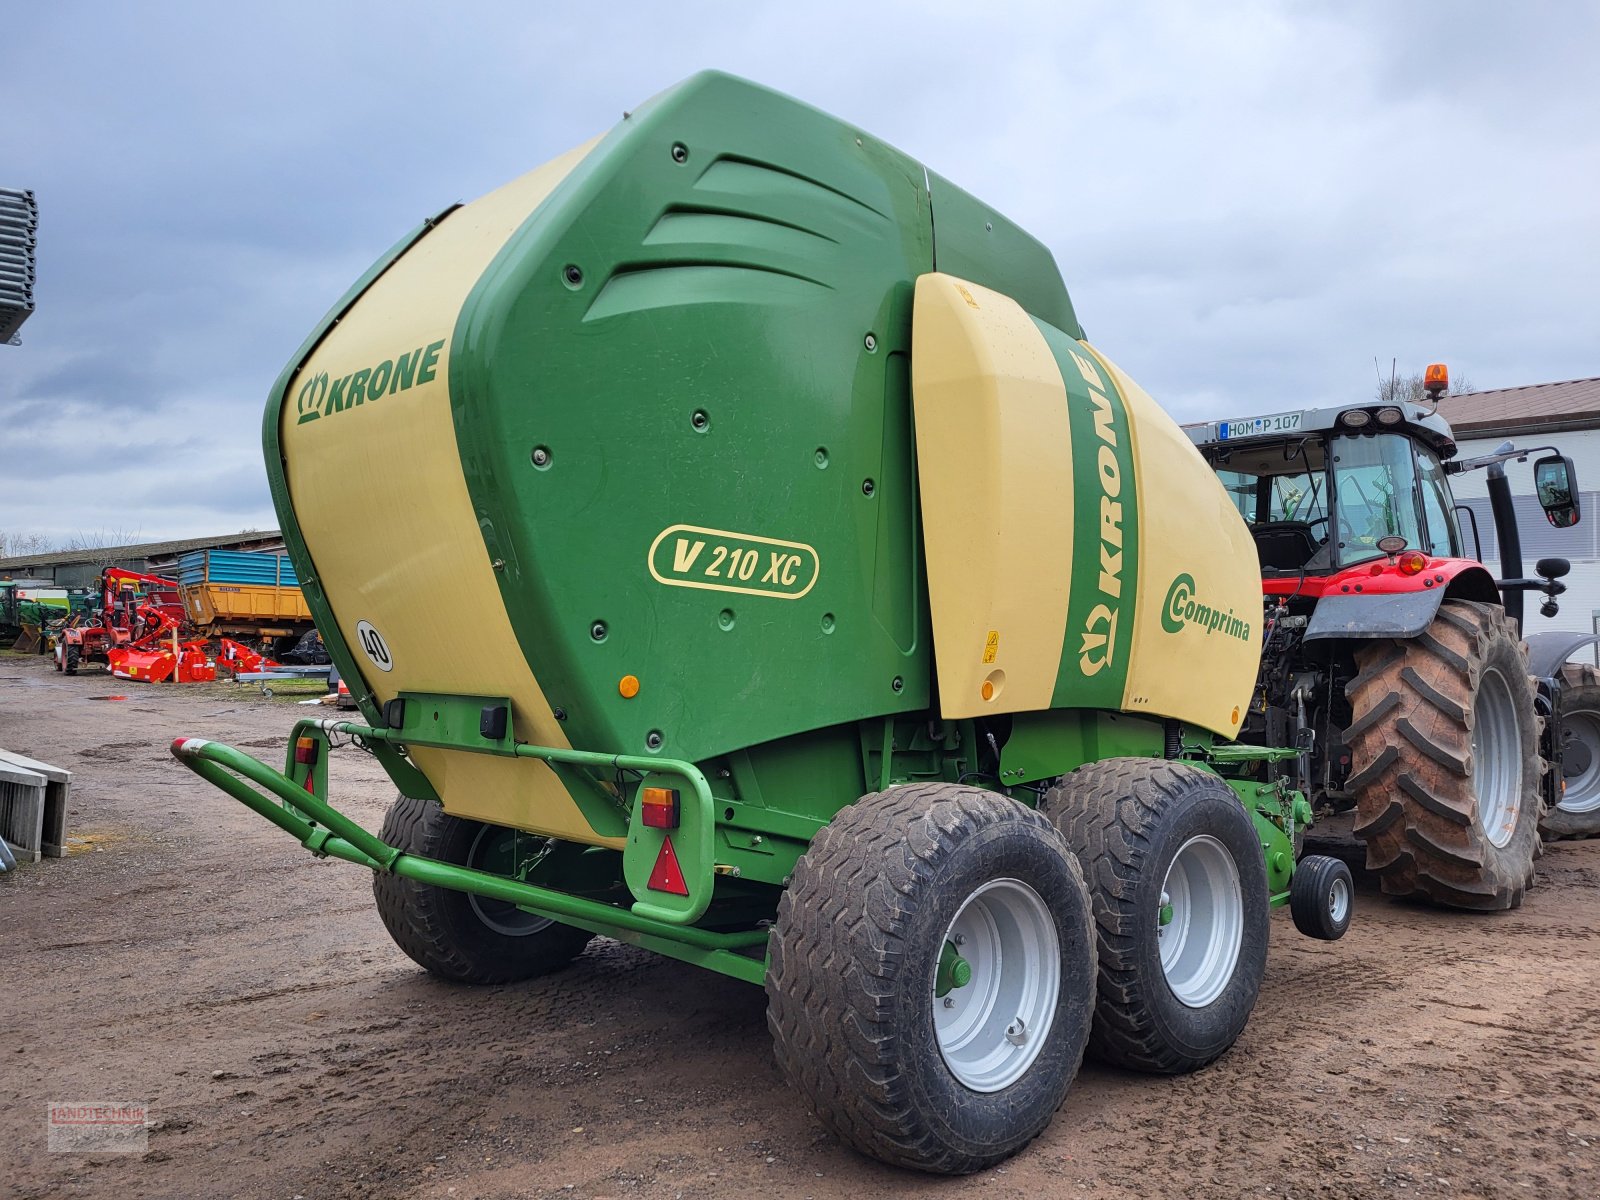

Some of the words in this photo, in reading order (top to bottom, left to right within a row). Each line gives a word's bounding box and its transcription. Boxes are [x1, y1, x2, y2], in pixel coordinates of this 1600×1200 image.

[324, 338, 446, 417] KRONE
[1229, 423, 1254, 437] HOM
[1263, 418, 1272, 432] P
[1274, 414, 1300, 430] 107
[1068, 349, 1123, 599] KRONE
[673, 538, 706, 573] V
[704, 545, 759, 581] 210
[761, 552, 802, 586] XC
[1161, 573, 1250, 641] Comprima
[360, 629, 390, 664] 40
